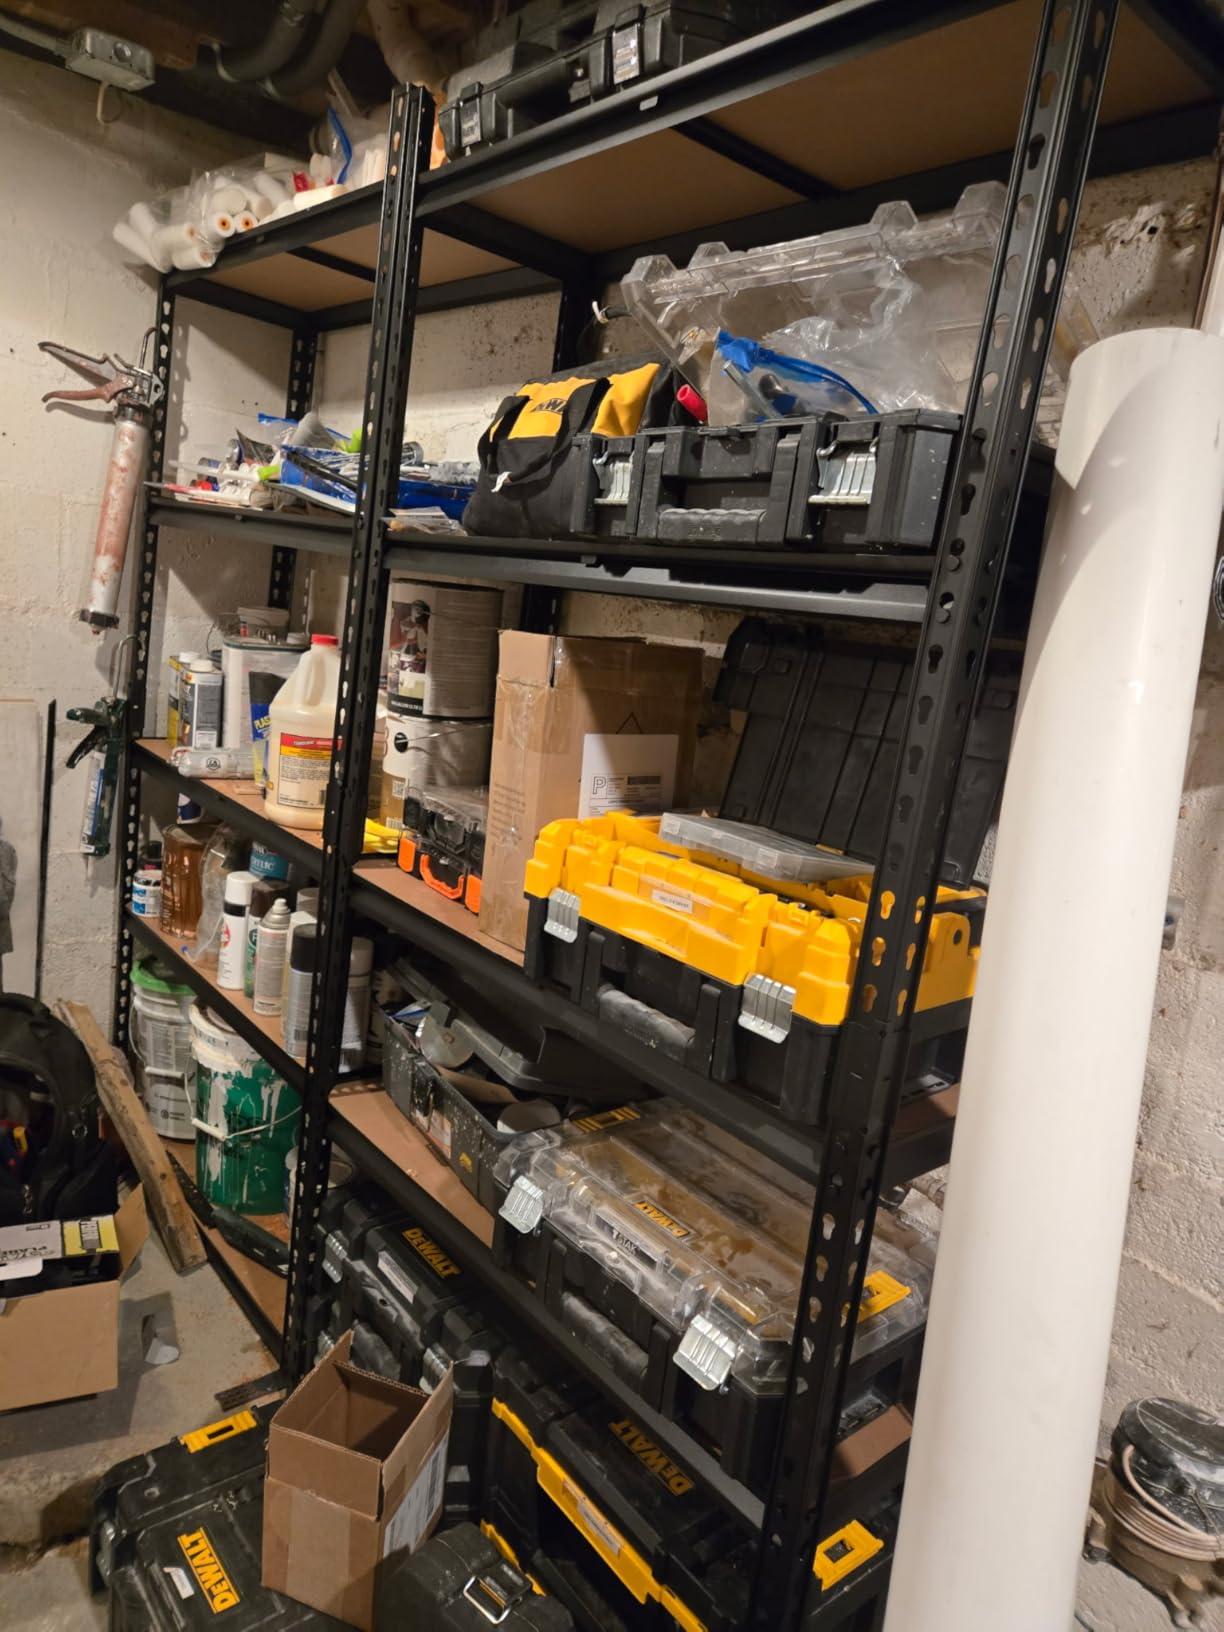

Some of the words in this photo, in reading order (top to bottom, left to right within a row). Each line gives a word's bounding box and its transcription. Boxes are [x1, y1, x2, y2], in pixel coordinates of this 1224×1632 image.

[634, 1200, 691, 1238] DEWALT
[402, 1228, 462, 1279] DEWALT
[608, 1419, 696, 1497] DEWALT
[178, 1528, 240, 1613] DEWALT
